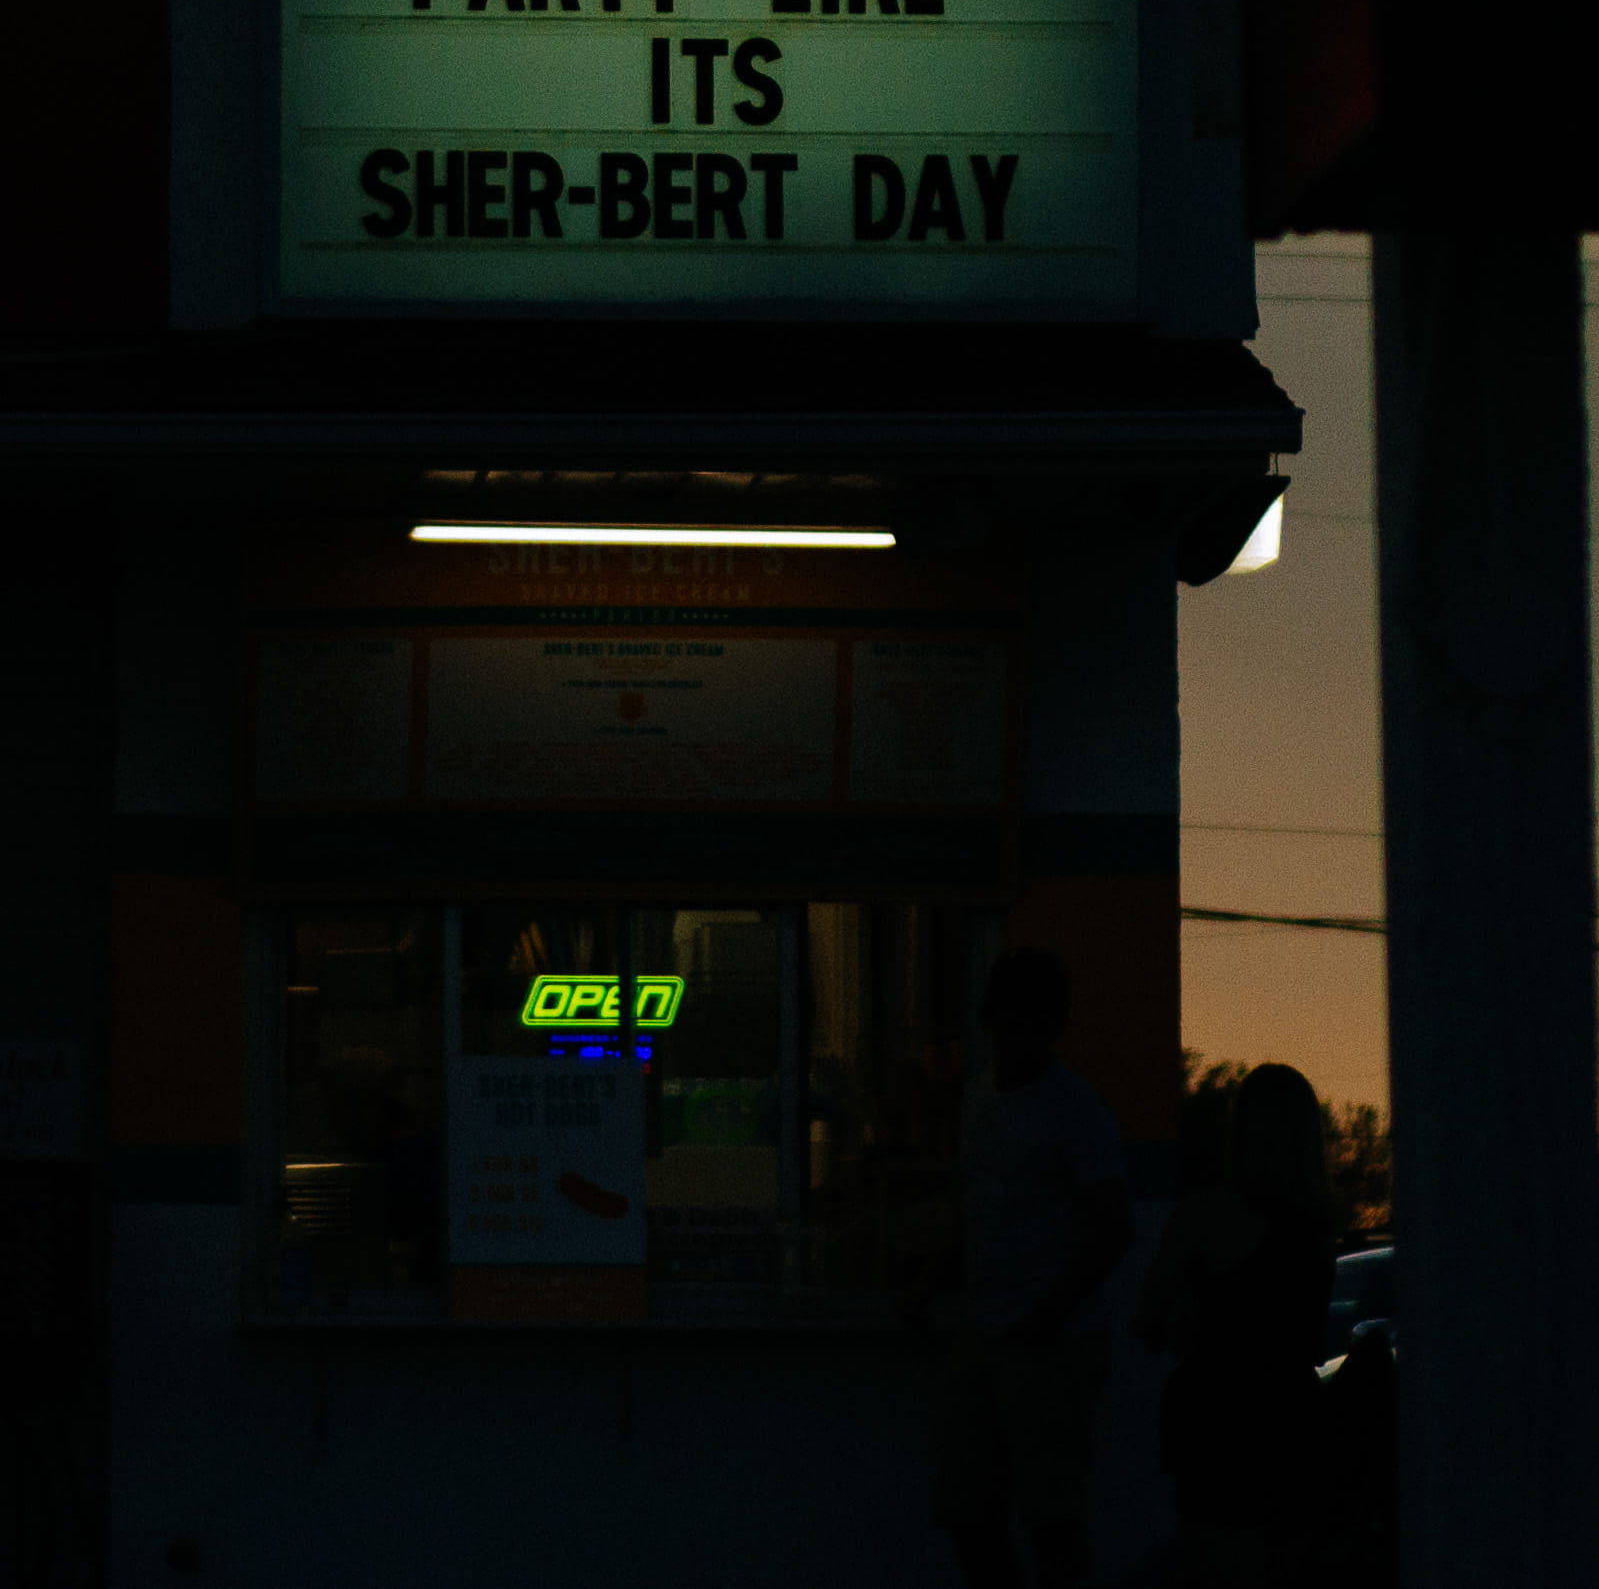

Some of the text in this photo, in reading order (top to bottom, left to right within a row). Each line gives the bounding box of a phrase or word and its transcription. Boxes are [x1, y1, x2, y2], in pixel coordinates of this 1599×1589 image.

[652, 37, 785, 125] ITS
[358, 148, 1020, 242] SHER-BERT DAY
